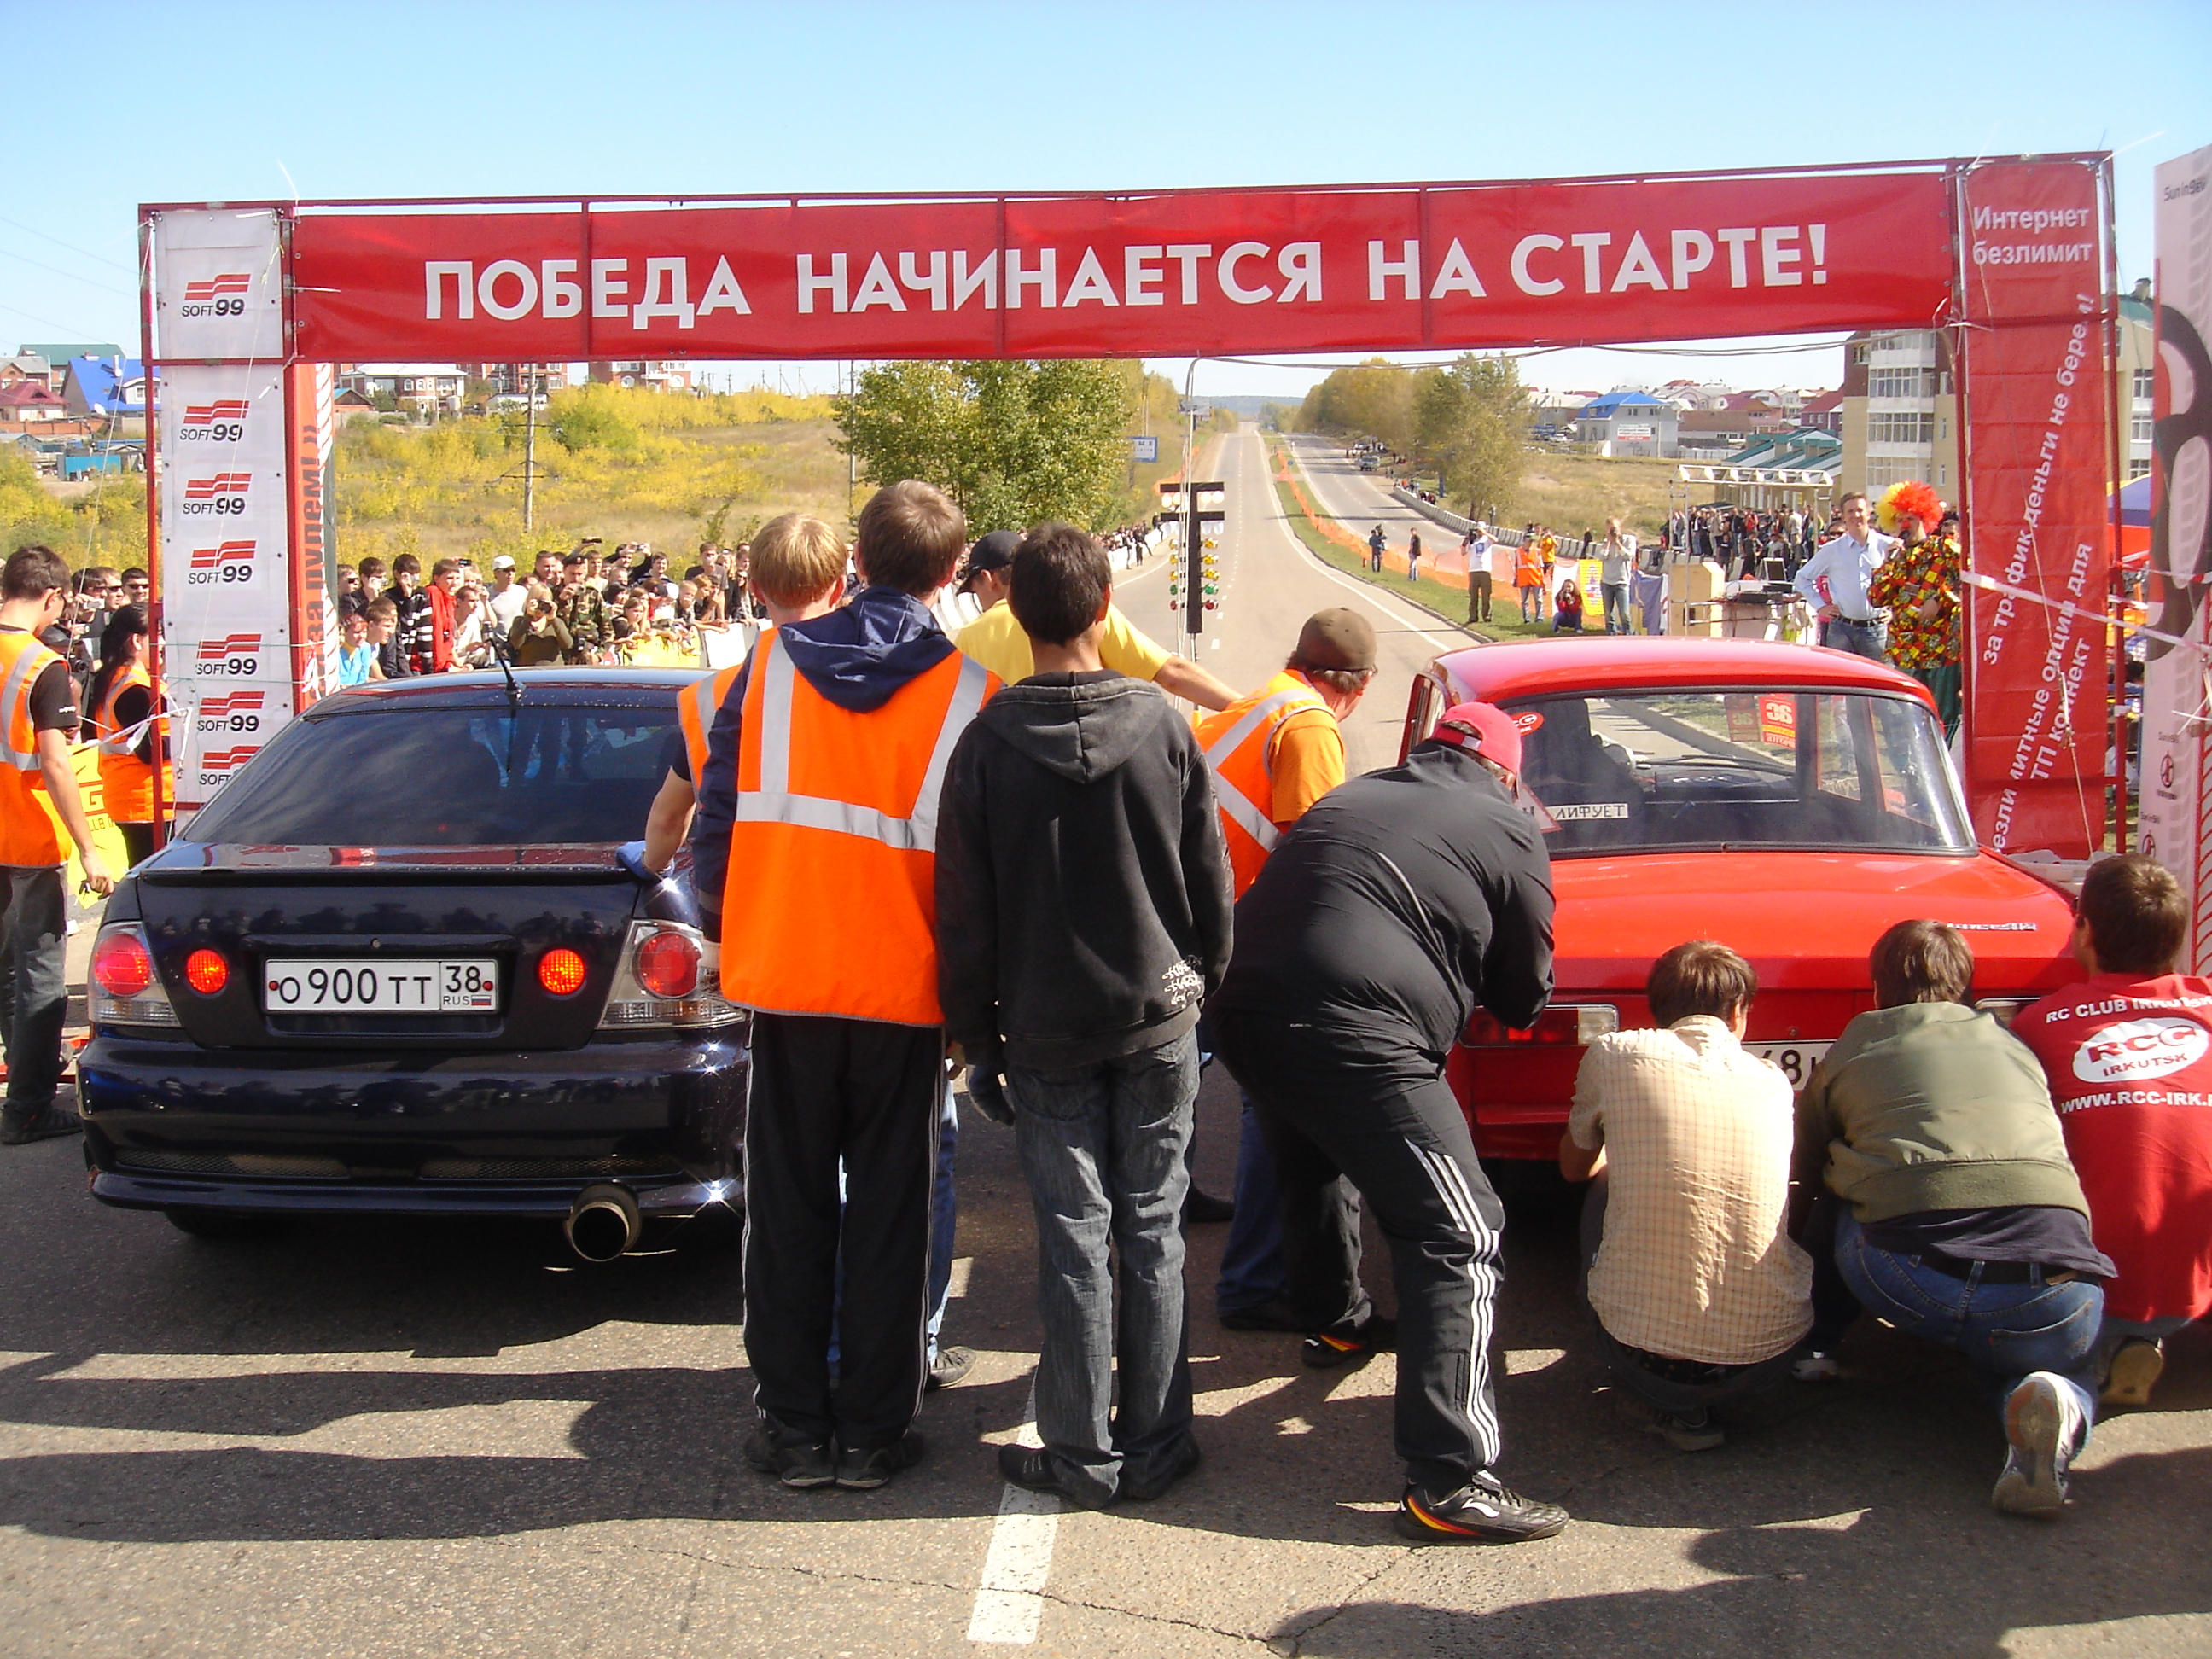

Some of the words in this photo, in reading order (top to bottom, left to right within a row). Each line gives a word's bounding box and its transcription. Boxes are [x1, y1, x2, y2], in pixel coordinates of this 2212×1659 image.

[1973, 206, 2090, 234] Интернет
[1972, 240, 2093, 265] безлимит
[424, 255, 752, 330] ПОБЕДА
[796, 241, 1322, 313] НАЧИНАЕТСЯ
[1368, 237, 1487, 300] НА
[1510, 223, 1827, 296] СТАРТЕ!
[181, 298, 246, 317] SOFT99
[2049, 393, 2069, 425] не
[179, 423, 243, 442] SOFT99
[2023, 430, 2059, 528] деньги
[183, 497, 246, 515] SOFT99
[188, 564, 253, 585] SOFT99
[1993, 529, 2033, 628] трфик
[2067, 543, 2093, 597] для
[1983, 634, 2004, 665] за
[196, 657, 258, 675] SOFT99
[197, 714, 259, 732] SOFT99
[2029, 745, 2058, 779] ТП
[199, 769, 239, 785] SOFT
[445, 965, 481, 993] 38
[443, 995, 469, 1005] RUS
[2046, 1008, 2070, 1023] RC
[2075, 998, 2128, 1018] CLUB
[2087, 1024, 2197, 1063] RCC
[2102, 1052, 2188, 1078] IRKUTSK
[2061, 1091, 2212, 1115] WWW.RCC-IRK.
